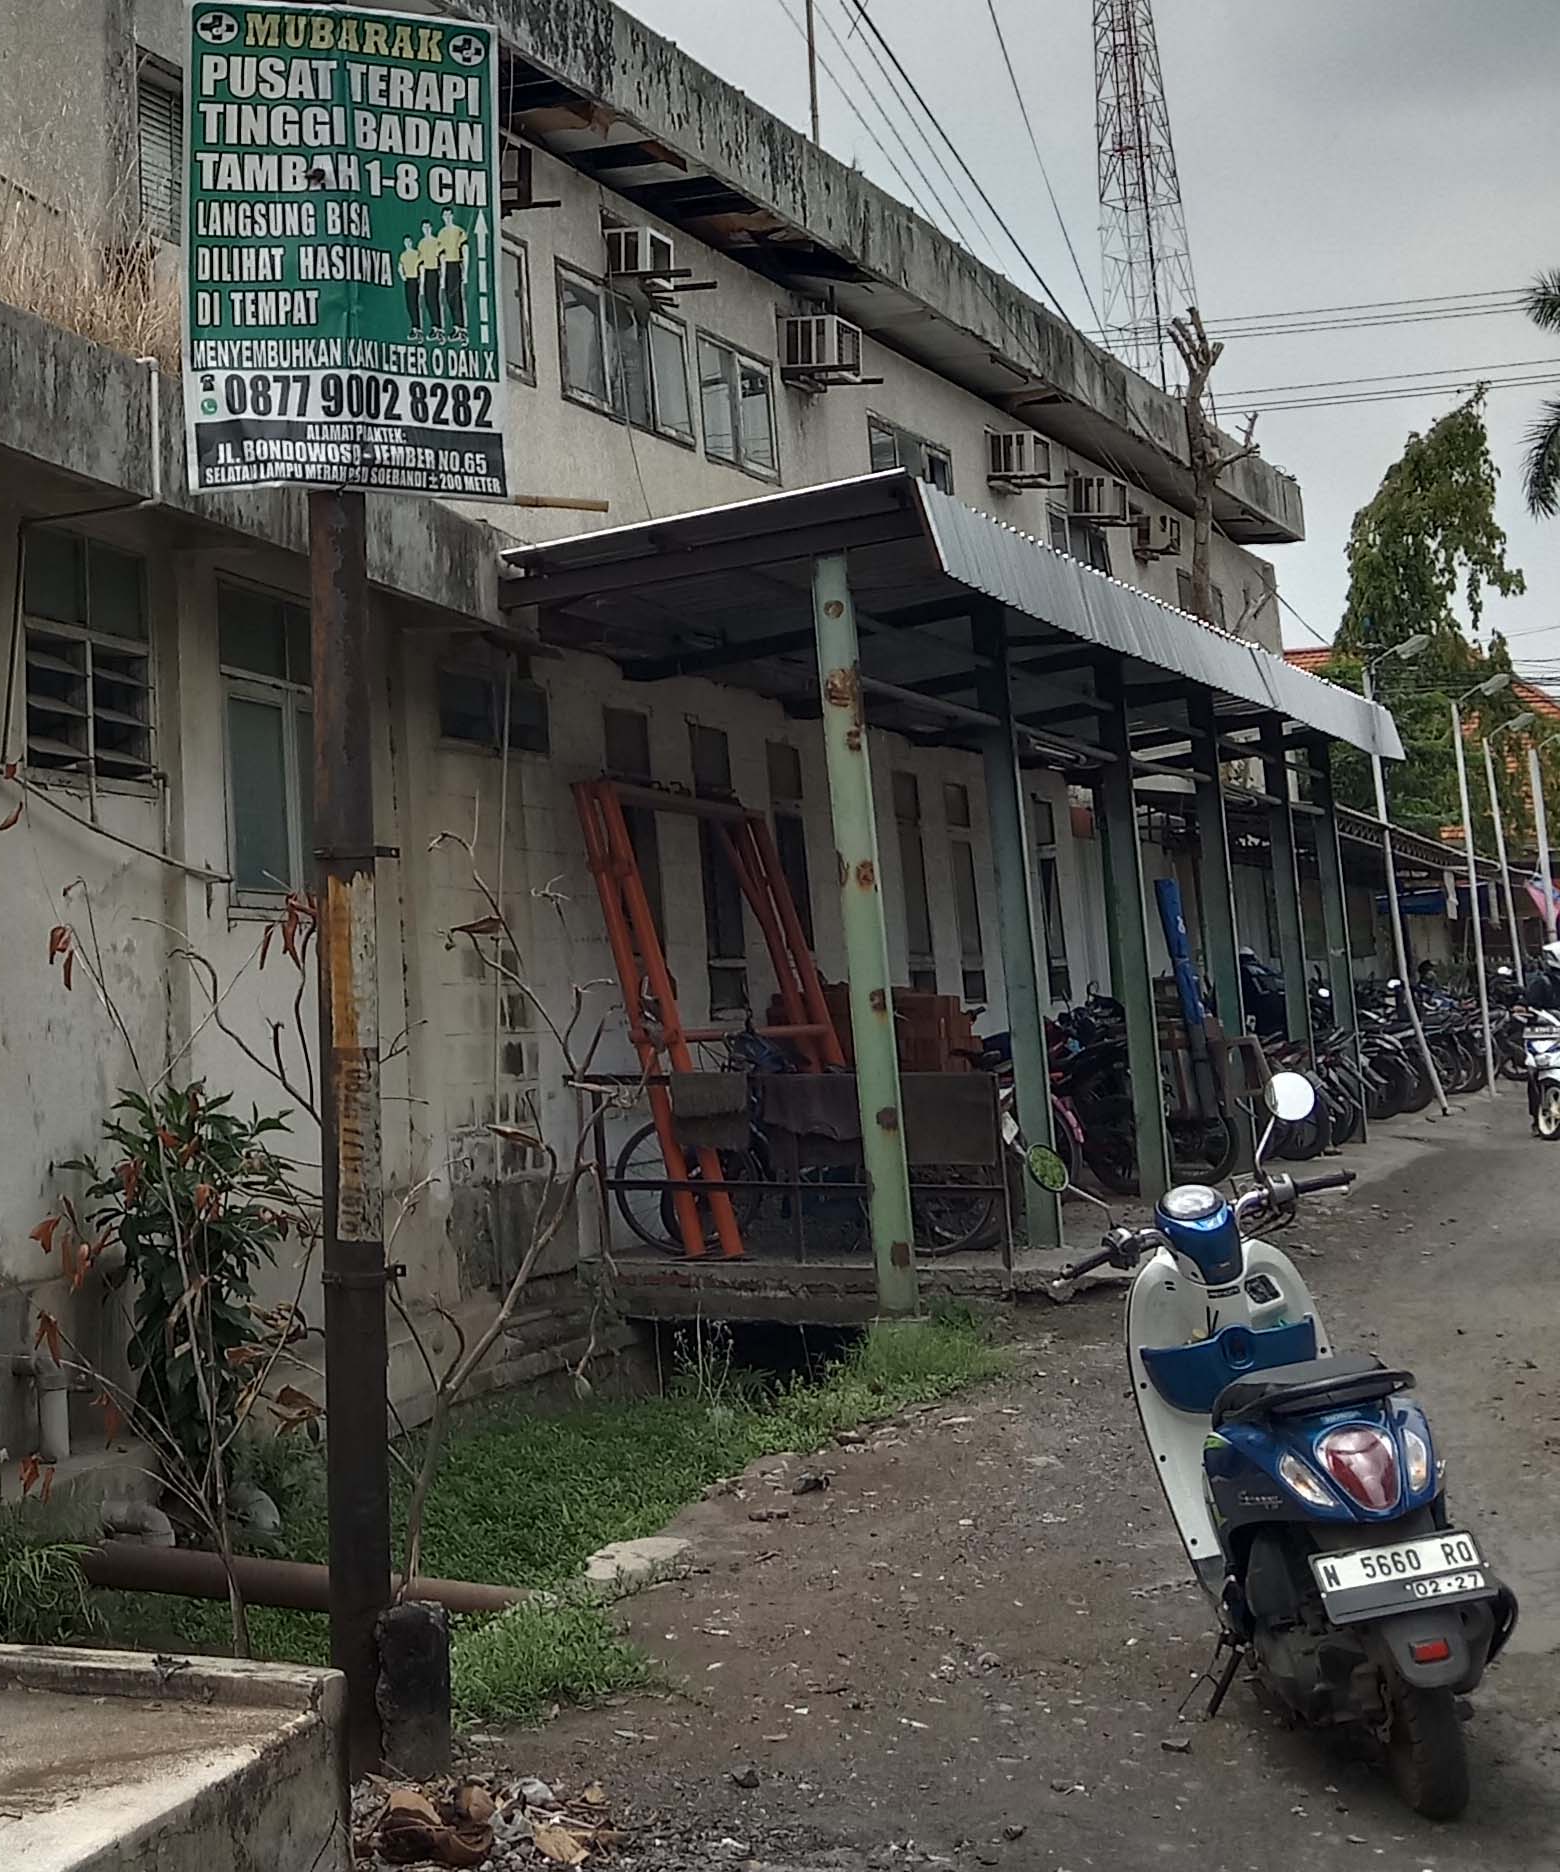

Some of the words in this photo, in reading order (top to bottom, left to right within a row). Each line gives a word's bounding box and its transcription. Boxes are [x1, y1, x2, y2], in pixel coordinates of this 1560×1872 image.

[245, 13, 443, 62] MUBARAK
[201, 54, 338, 100] PUSAT
[346, 63, 481, 117] TERAPI
[199, 104, 346, 147] TINGGI
[354, 109, 483, 162] BADAN
[196, 153, 361, 192] TAMBAH
[365, 160, 419, 200] 1-8
[429, 167, 487, 207] CM
[197, 201, 315, 237] LANGSUNG
[326, 201, 371, 239] BISA
[197, 246, 284, 281] DILIHAT
[299, 245, 393, 286] HASILNYA
[197, 291, 220, 326] DI
[229, 290, 319, 326] TEMPAT
[193, 338, 341, 369] MENYEMBUHKAN
[347, 338, 379, 369] KAKI
[382, 342, 428, 375] LETER
[432, 347, 444, 376] O
[447, 348, 480, 378] DAN
[483, 351, 496, 379] X
[224, 373, 310, 417] 0877
[321, 373, 402, 421] 9002
[409, 381, 493, 428] 8282
[306, 424, 354, 441] ALAMAT
[217, 443, 241, 465] JL.
[242, 439, 360, 465] BONDOWOSO
[373, 444, 436, 470] JEMBER
[205, 464, 257, 484] SELATAN
[259, 461, 303, 479] LAMPU
[305, 463, 347, 482] MERAH
[370, 467, 427, 488] SOEBANDI
[440, 473, 462, 491] 200
[463, 476, 502, 494] METER
[1322, 1564, 1341, 1588] N
[1360, 1548, 1421, 1579] 5660
